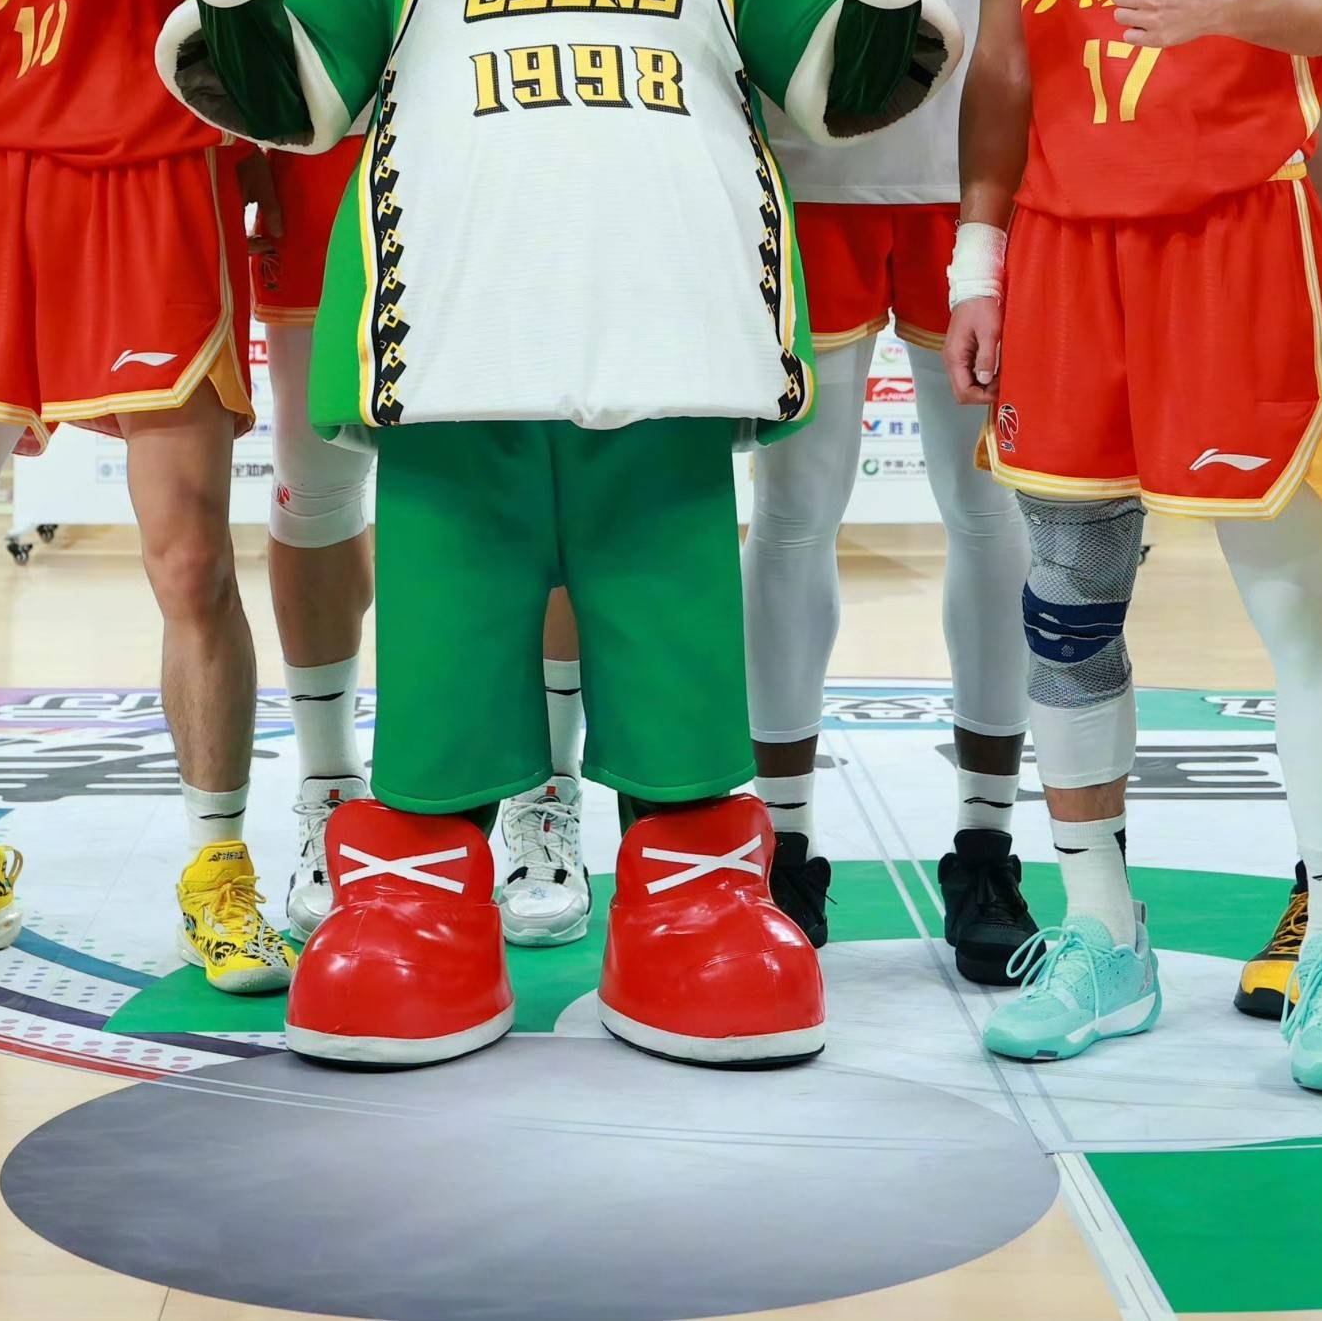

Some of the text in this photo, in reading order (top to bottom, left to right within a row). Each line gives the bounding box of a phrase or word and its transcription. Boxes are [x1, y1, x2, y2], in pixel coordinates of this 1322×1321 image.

[14, 0, 68, 80] 10
[469, 43, 691, 117] 1998
[1083, 38, 1163, 124] 17
